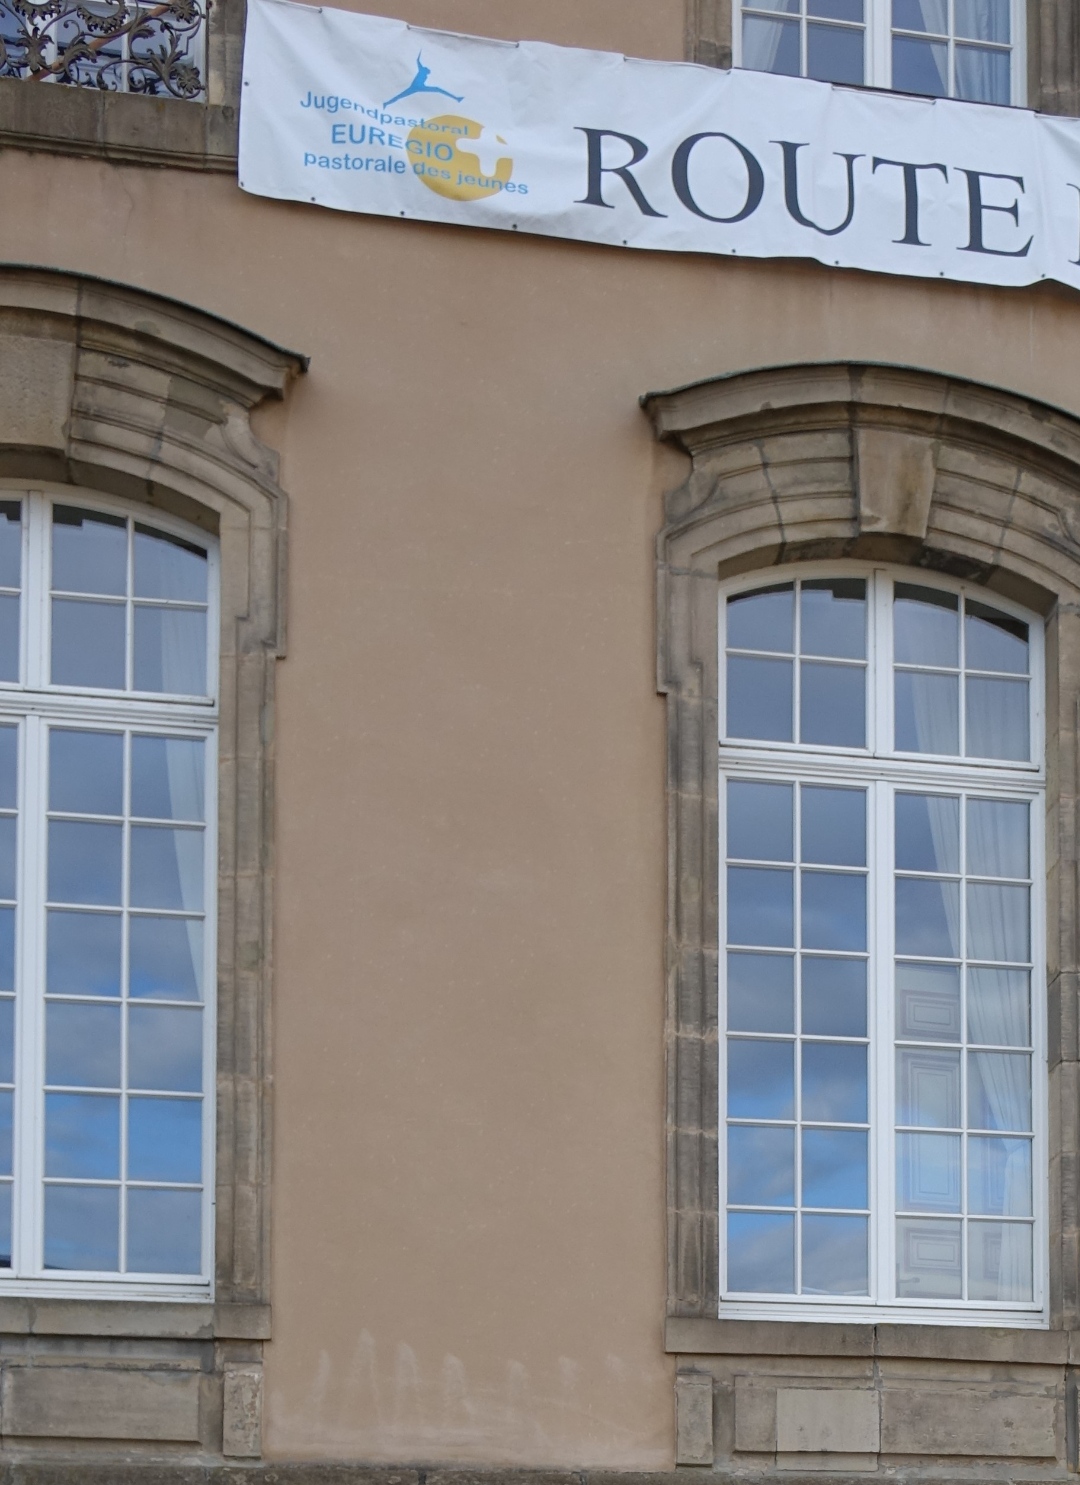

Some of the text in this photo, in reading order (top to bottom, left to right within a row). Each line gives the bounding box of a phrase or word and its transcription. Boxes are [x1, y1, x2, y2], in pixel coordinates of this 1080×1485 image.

[300, 91, 469, 136] Jugendpastoral
[331, 123, 454, 162] EUREGIO
[304, 152, 529, 194] pastorale des jeunes
[573, 126, 1034, 257] ROUTE
